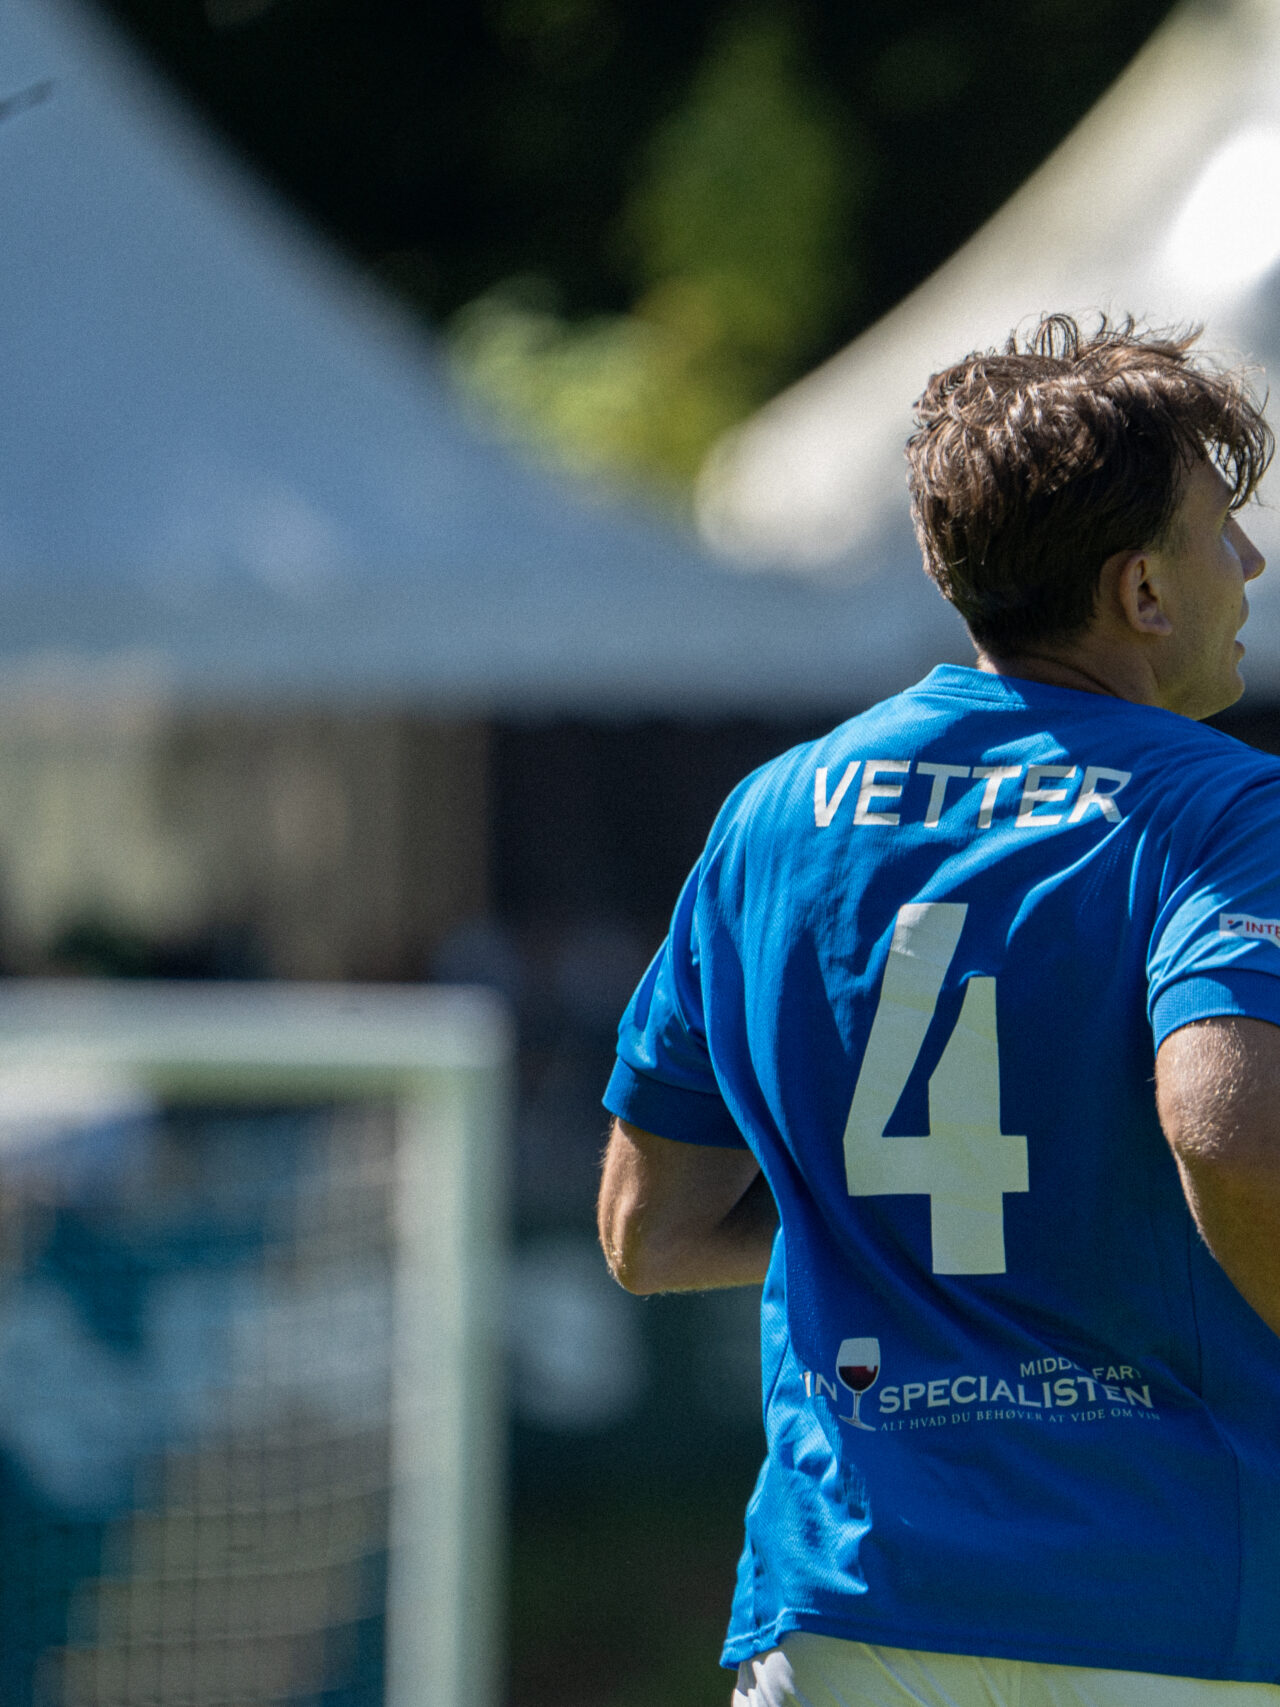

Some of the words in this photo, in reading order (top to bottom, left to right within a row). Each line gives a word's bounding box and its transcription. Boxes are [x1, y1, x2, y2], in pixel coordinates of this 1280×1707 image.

[813, 760, 1132, 829] VETTER
[843, 902, 1029, 1275] 4
[1020, 1356, 1141, 1381] MIDDFAR
[799, 1371, 838, 1402] IN
[879, 1375, 1154, 1414] SPECIALISTEN
[881, 1420, 905, 1432] ALT
[910, 1415, 947, 1430] HVAD
[951, 1412, 971, 1424] DU
[976, 1408, 1043, 1421] BEHØVER
[1050, 1413, 1065, 1424] AT
[1071, 1408, 1106, 1423] VIDE
[1110, 1407, 1133, 1418] OM
